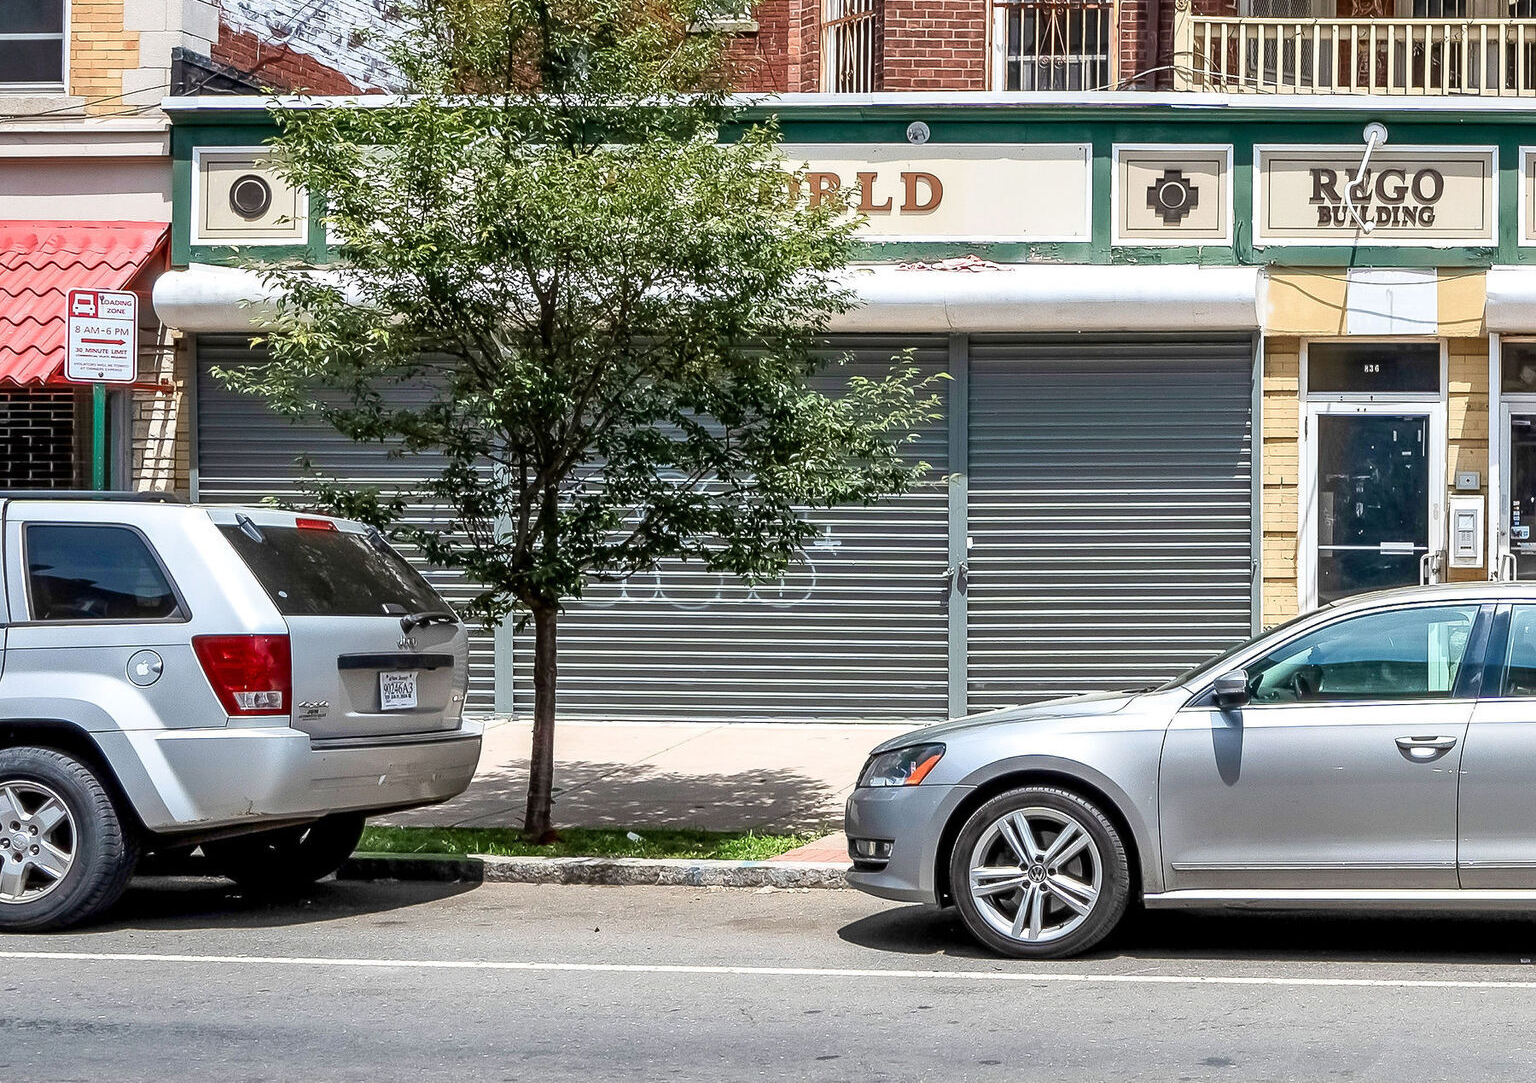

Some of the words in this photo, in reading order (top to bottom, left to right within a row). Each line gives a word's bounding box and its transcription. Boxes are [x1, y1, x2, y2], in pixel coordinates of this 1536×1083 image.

[1309, 167, 1445, 205] REGO
[1316, 206, 1436, 227] BUILDING
[106, 307, 126, 315] ZONE
[75, 325, 81, 333] 8
[114, 327, 129, 336] PM
[1364, 364, 1380, 373] 836
